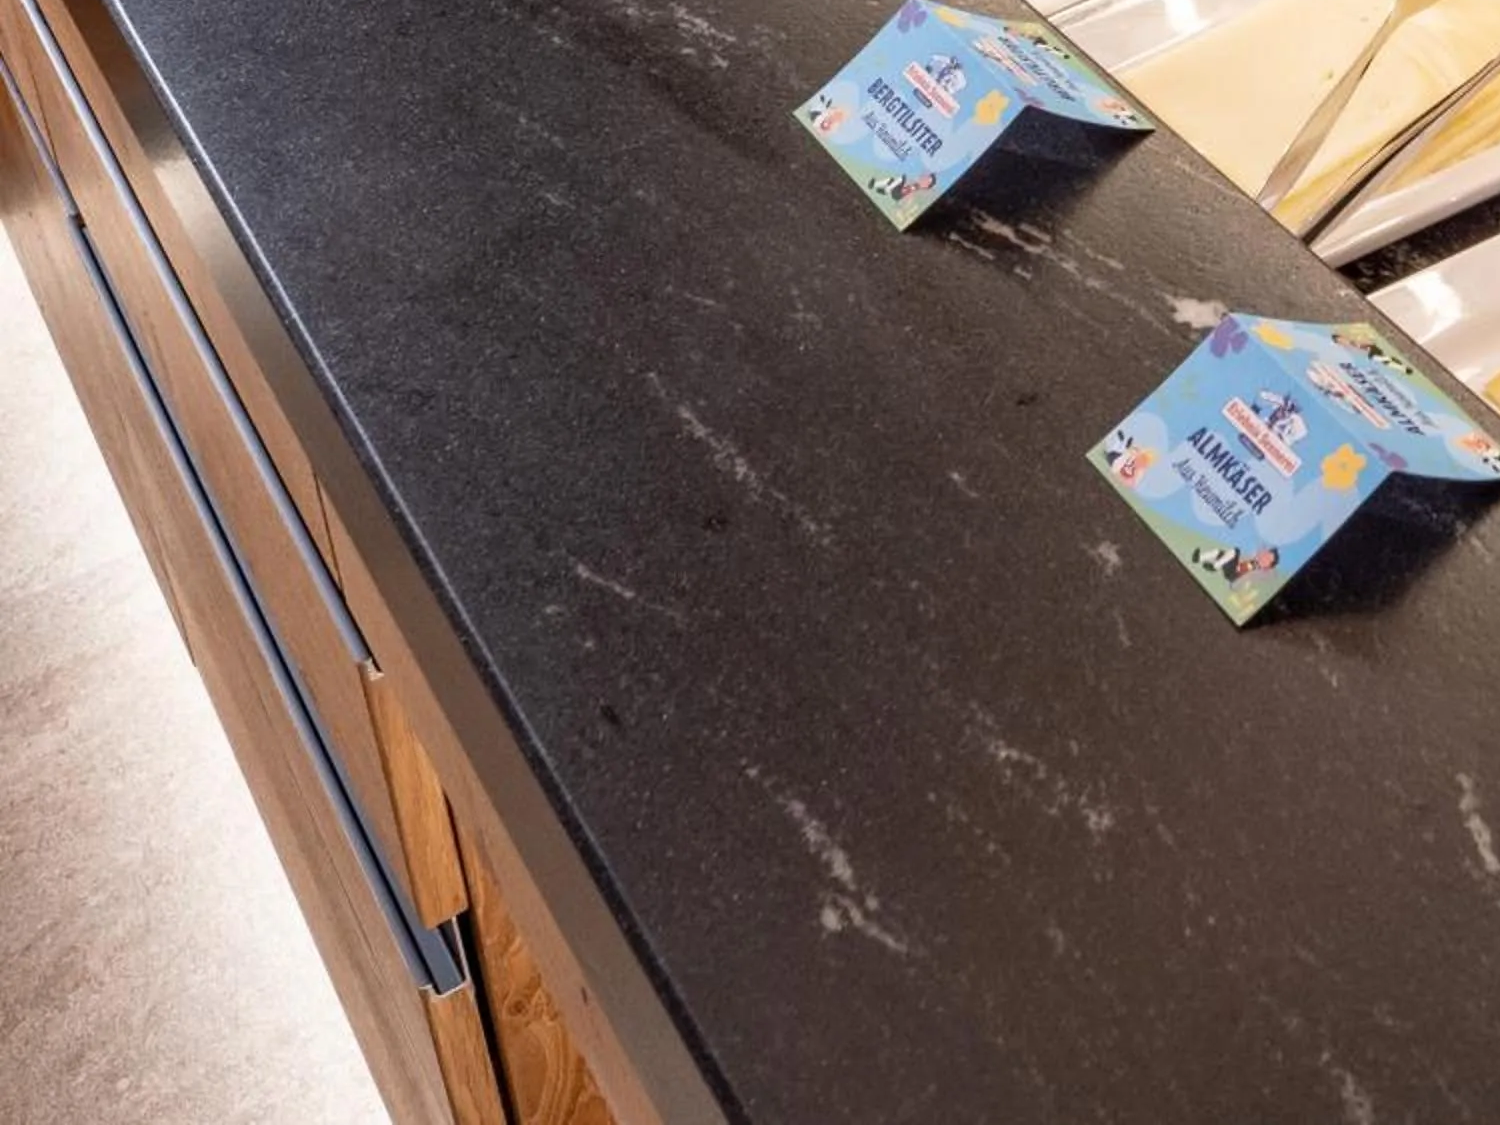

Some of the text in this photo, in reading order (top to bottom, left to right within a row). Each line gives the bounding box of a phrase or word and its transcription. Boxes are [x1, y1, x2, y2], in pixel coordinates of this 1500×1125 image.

[867, 77, 943, 158] BERGTILSITER
[1171, 458, 1197, 482] Aus
[1186, 426, 1273, 516] ALMKÄSER
